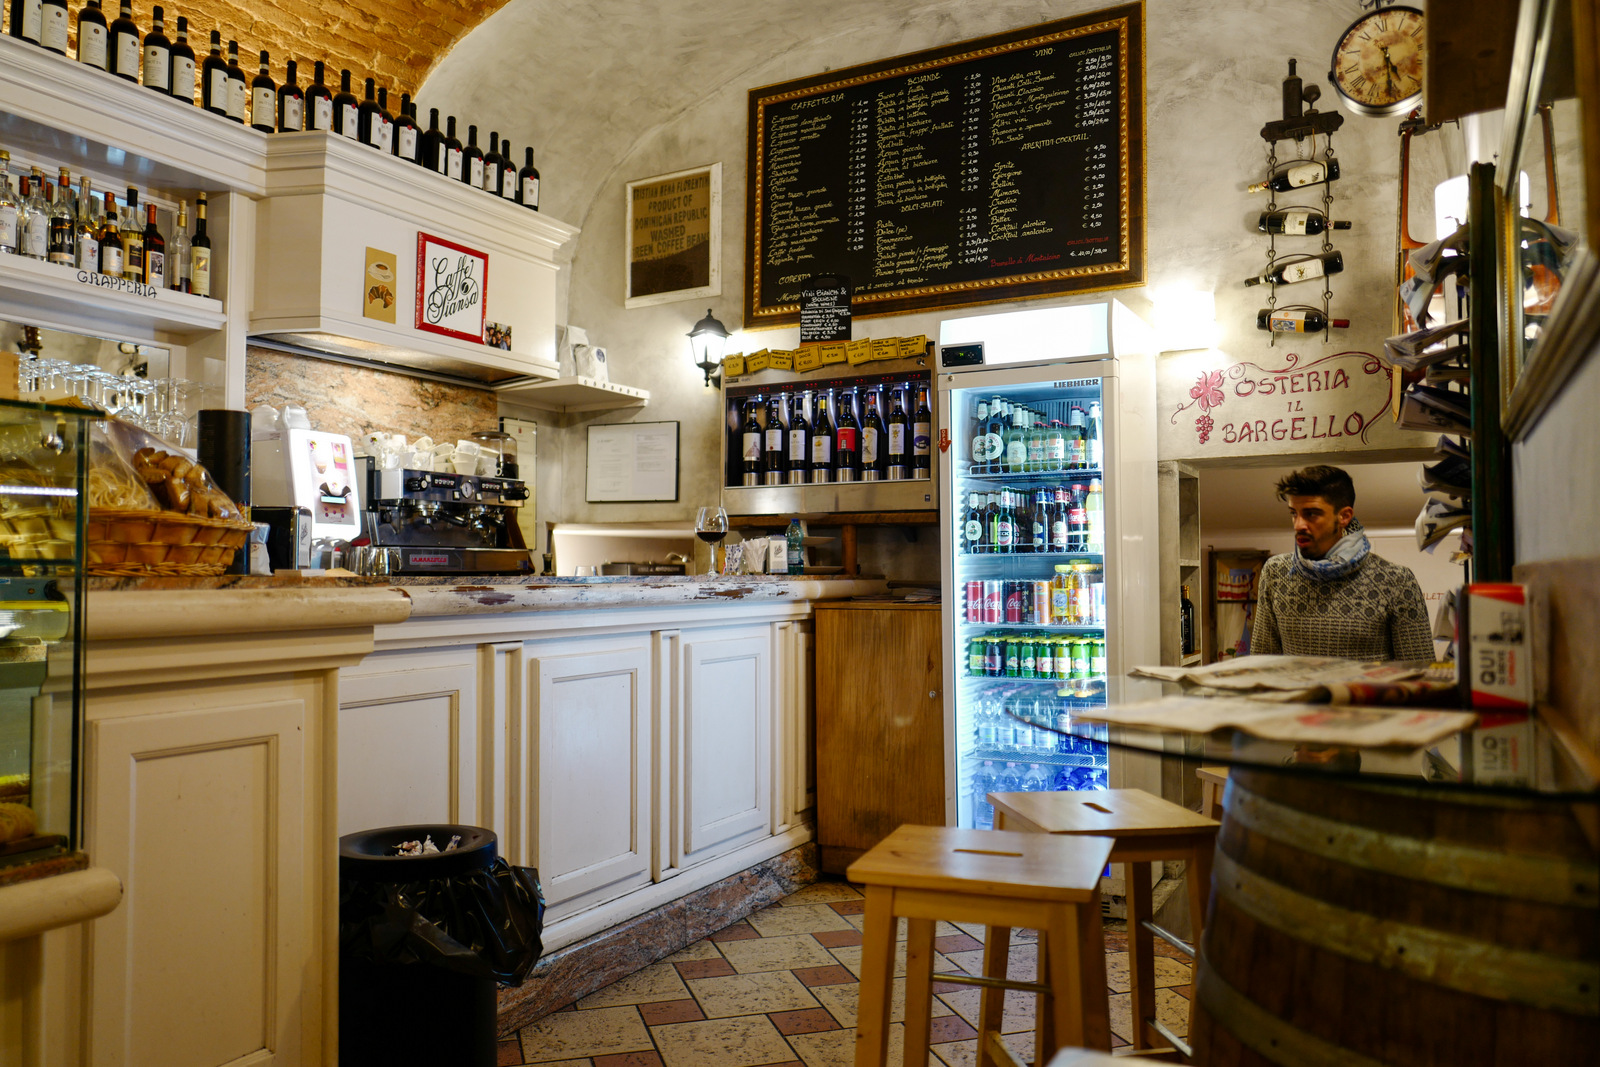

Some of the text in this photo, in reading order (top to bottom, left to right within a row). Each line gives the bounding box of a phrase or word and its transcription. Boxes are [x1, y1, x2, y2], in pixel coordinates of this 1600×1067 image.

[1035, 48, 1053, 58] VINO
[791, 93, 844, 110] CAFFETTERIA
[1056, 133, 1089, 145] COCKTAIL
[648, 194, 692, 213] PRODUCT OF
[989, 205, 1018, 217] Campari
[634, 207, 708, 230] DOMINICAN REPUBLIC
[650, 224, 686, 242] WASHED
[656, 237, 684, 254] COFFEE
[76, 270, 158, 298] GRAPPERIA
[840, 287, 847, 295] &
[1054, 378, 1099, 389] LIEBHERR
[1234, 368, 1350, 398] OSTERIA
[1287, 400, 1304, 412] IL
[1221, 411, 1364, 444] BARGELLO
[1479, 650, 1496, 686] QUI
